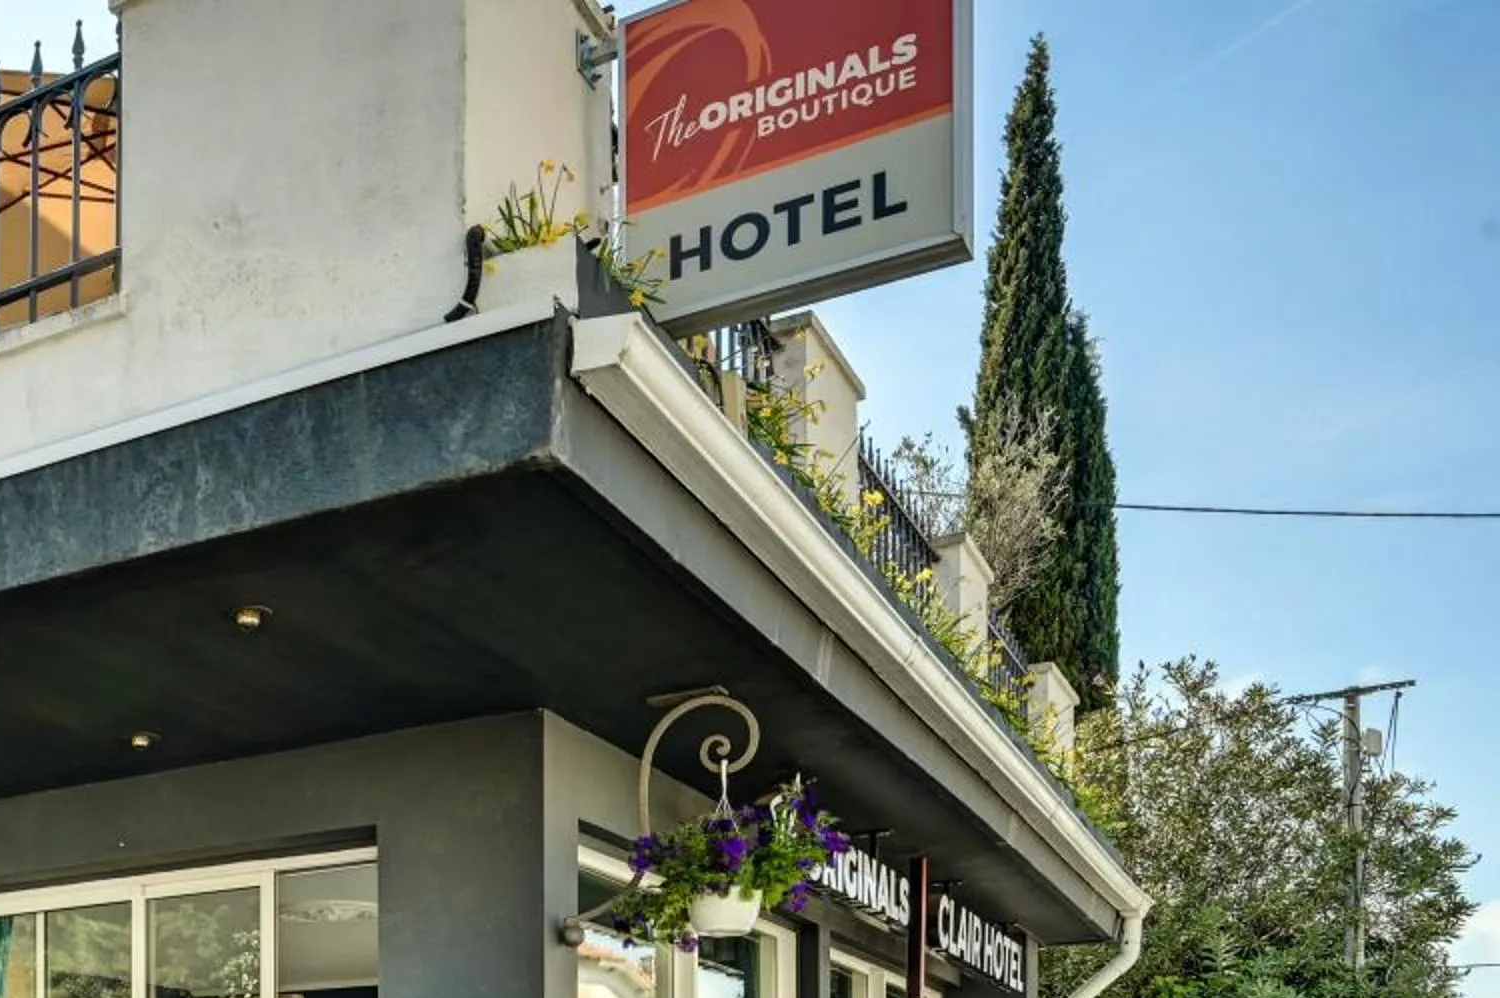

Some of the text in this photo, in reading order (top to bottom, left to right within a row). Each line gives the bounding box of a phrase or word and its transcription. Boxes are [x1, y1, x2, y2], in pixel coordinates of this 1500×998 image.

[644, 33, 918, 162] The ORIGINALS
[757, 66, 918, 139] BOUTIQUE
[669, 171, 908, 280] HOTEL
[808, 846, 1024, 992] RIGINALS CLAIR HOTEL
